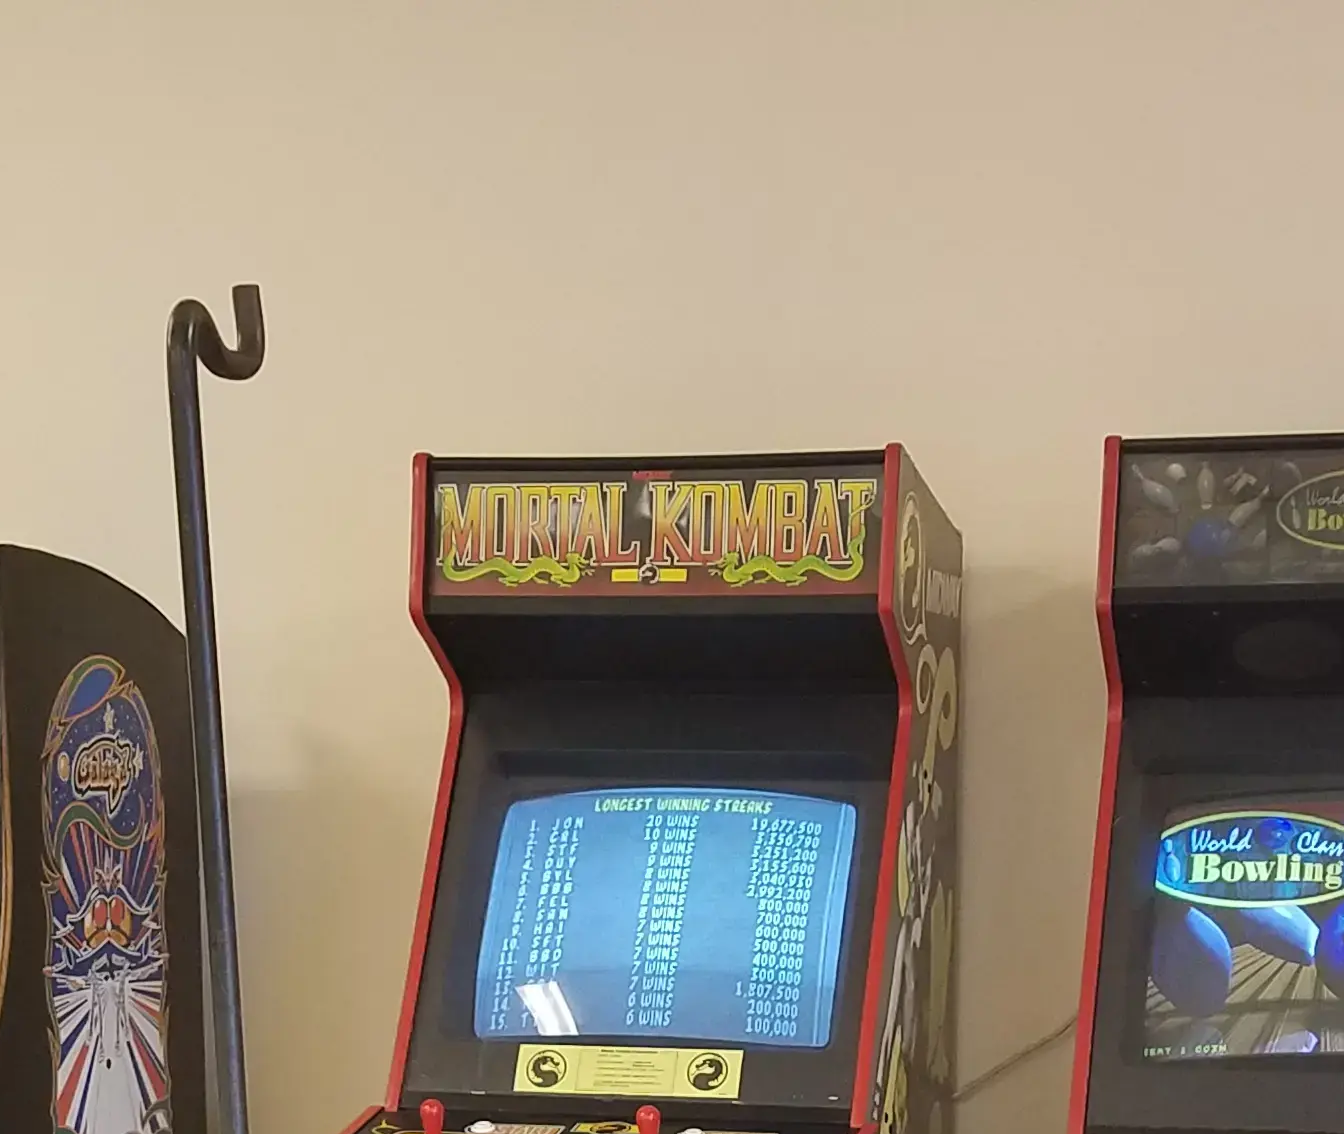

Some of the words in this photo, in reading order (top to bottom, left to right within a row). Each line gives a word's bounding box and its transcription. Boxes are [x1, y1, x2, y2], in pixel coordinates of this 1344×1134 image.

[436, 481, 642, 566] MORTAL
[646, 479, 877, 566] KOMBAT
[595, 798, 652, 812] LONGEST
[657, 798, 710, 811] WINNING
[714, 799, 773, 814] STREAKS
[530, 820, 539, 831] 1.
[552, 817, 584, 831] JON
[646, 815, 662, 827] 20
[667, 815, 700, 827] WINS
[752, 818, 822, 835] 19,677,500
[527, 833, 538, 844] 2.
[644, 828, 660, 840] 10
[665, 829, 697, 841] WINS
[756, 832, 820, 848] 3,356,790
[650, 842, 658, 853] 9
[662, 842, 695, 854] WINS
[1190, 827, 1254, 852] World
[1296, 830, 1344, 857] Class
[648, 855, 656, 866] 9
[660, 855, 692, 867] WINS
[1188, 852, 1344, 890] Bowling
[658, 868, 690, 880] WINS
[656, 881, 688, 893] WINS
[746, 885, 811, 901] 2,992,200
[653, 894, 686, 906] WINS
[758, 899, 809, 914] 800,000
[651, 907, 684, 919] WINS
[757, 912, 807, 928] 700,000
[637, 920, 646, 932] 7
[650, 920, 683, 933] WINS
[756, 925, 805, 941] 600,000
[502, 938, 520, 951] 10.
[635, 933, 644, 945] 7
[648, 933, 681, 946] WINS
[753, 939, 804, 956] 500,000
[499, 951, 517, 965] 11.
[634, 947, 642, 960] 7
[646, 947, 679, 960] WINS
[753, 953, 802, 970] 400,000
[632, 961, 641, 974] 7
[645, 961, 677, 976] WINS
[751, 968, 801, 985] 300,000
[629, 976, 638, 990] 7
[643, 977, 675, 991] WINS
[735, 981, 799, 1001] 1,807,500
[628, 992, 636, 1007] 6
[641, 992, 673, 1008] WINS
[747, 1000, 798, 1019] 200,000
[490, 1013, 507, 1030] 15.
[626, 1009, 634, 1026] 6
[639, 1010, 672, 1026] WINS
[745, 1016, 796, 1037] 100,000
